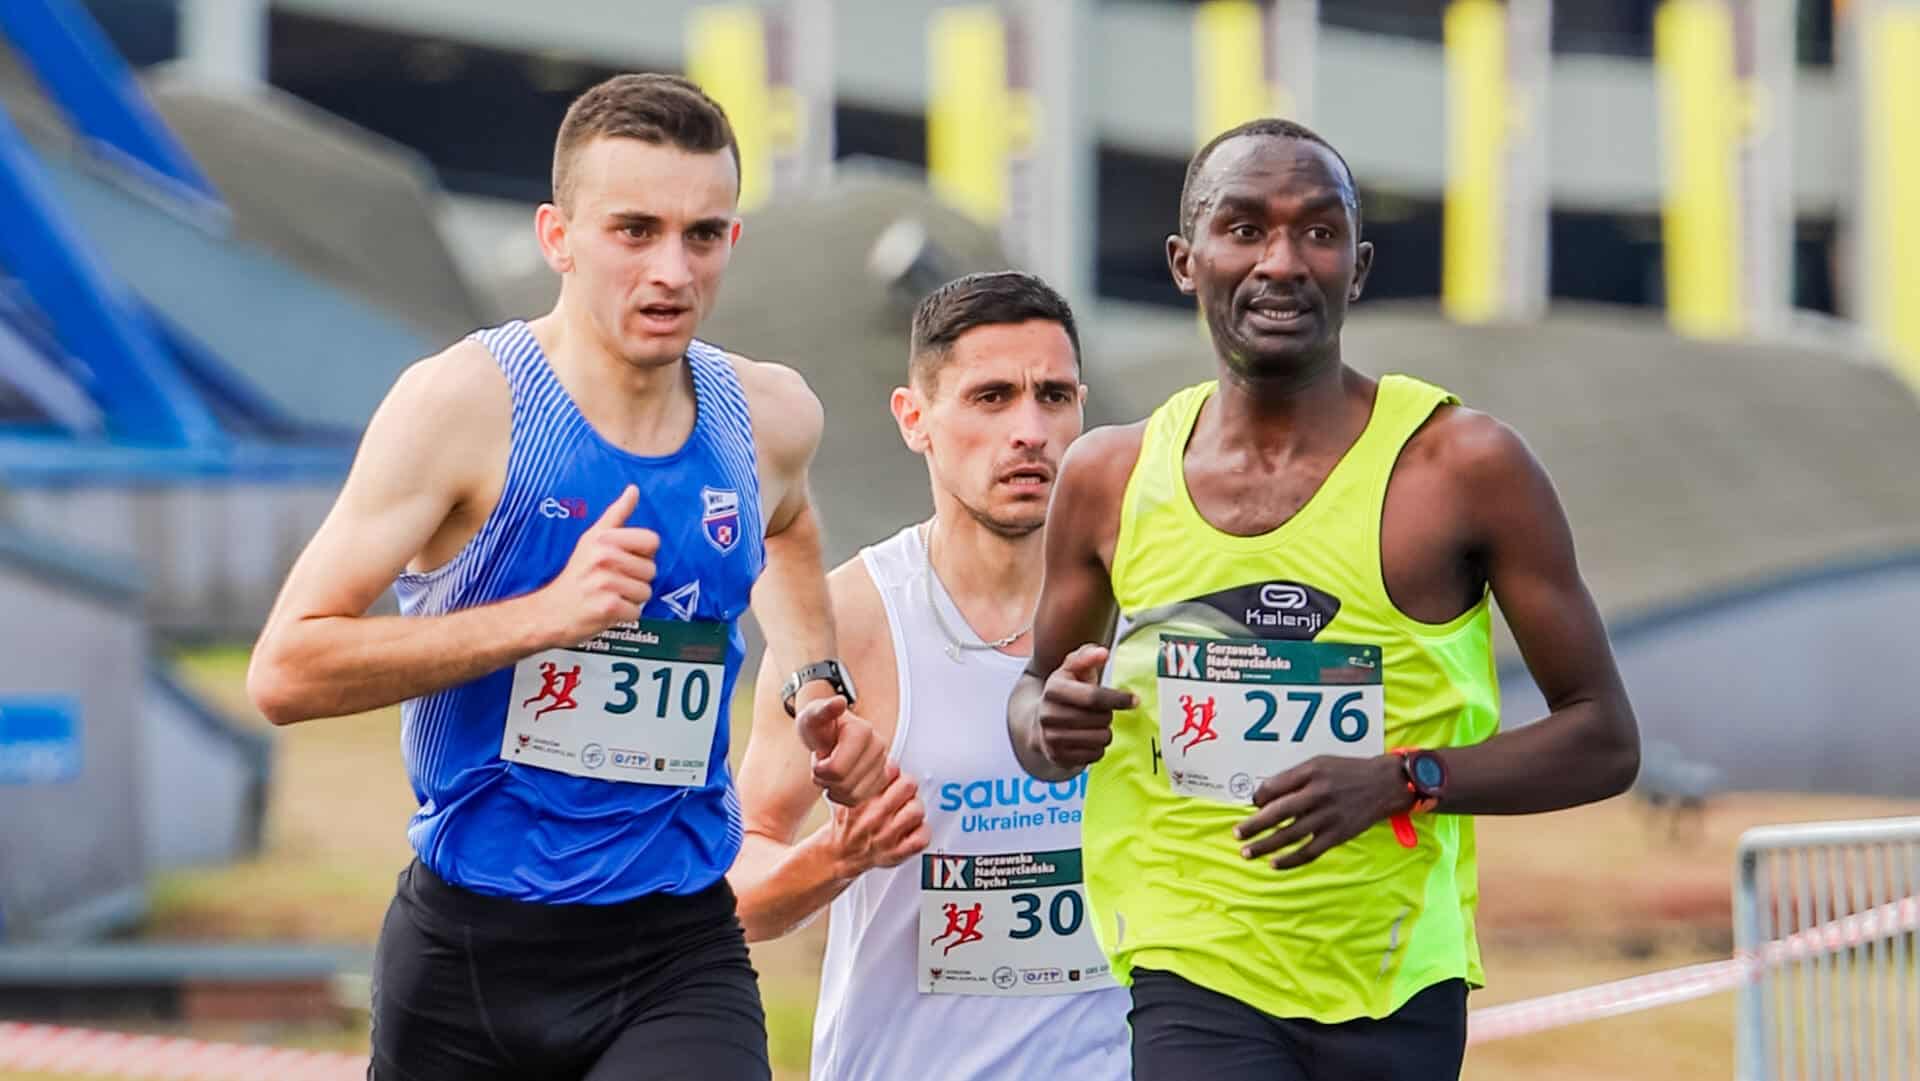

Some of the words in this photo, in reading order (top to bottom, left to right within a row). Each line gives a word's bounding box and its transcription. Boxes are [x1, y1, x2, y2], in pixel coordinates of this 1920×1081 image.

[1245, 608, 1322, 633] Kalenji
[1166, 640, 1200, 679] IX
[1206, 667, 1241, 681] Dycha
[603, 661, 711, 721] 310
[1243, 689, 1370, 743] 276
[961, 811, 1045, 833] Ukraine
[933, 857, 969, 889] IX
[974, 877, 1008, 890] Dycha
[975, 862, 1056, 877] Nadwarciańska
[1009, 889, 1084, 940] 30
